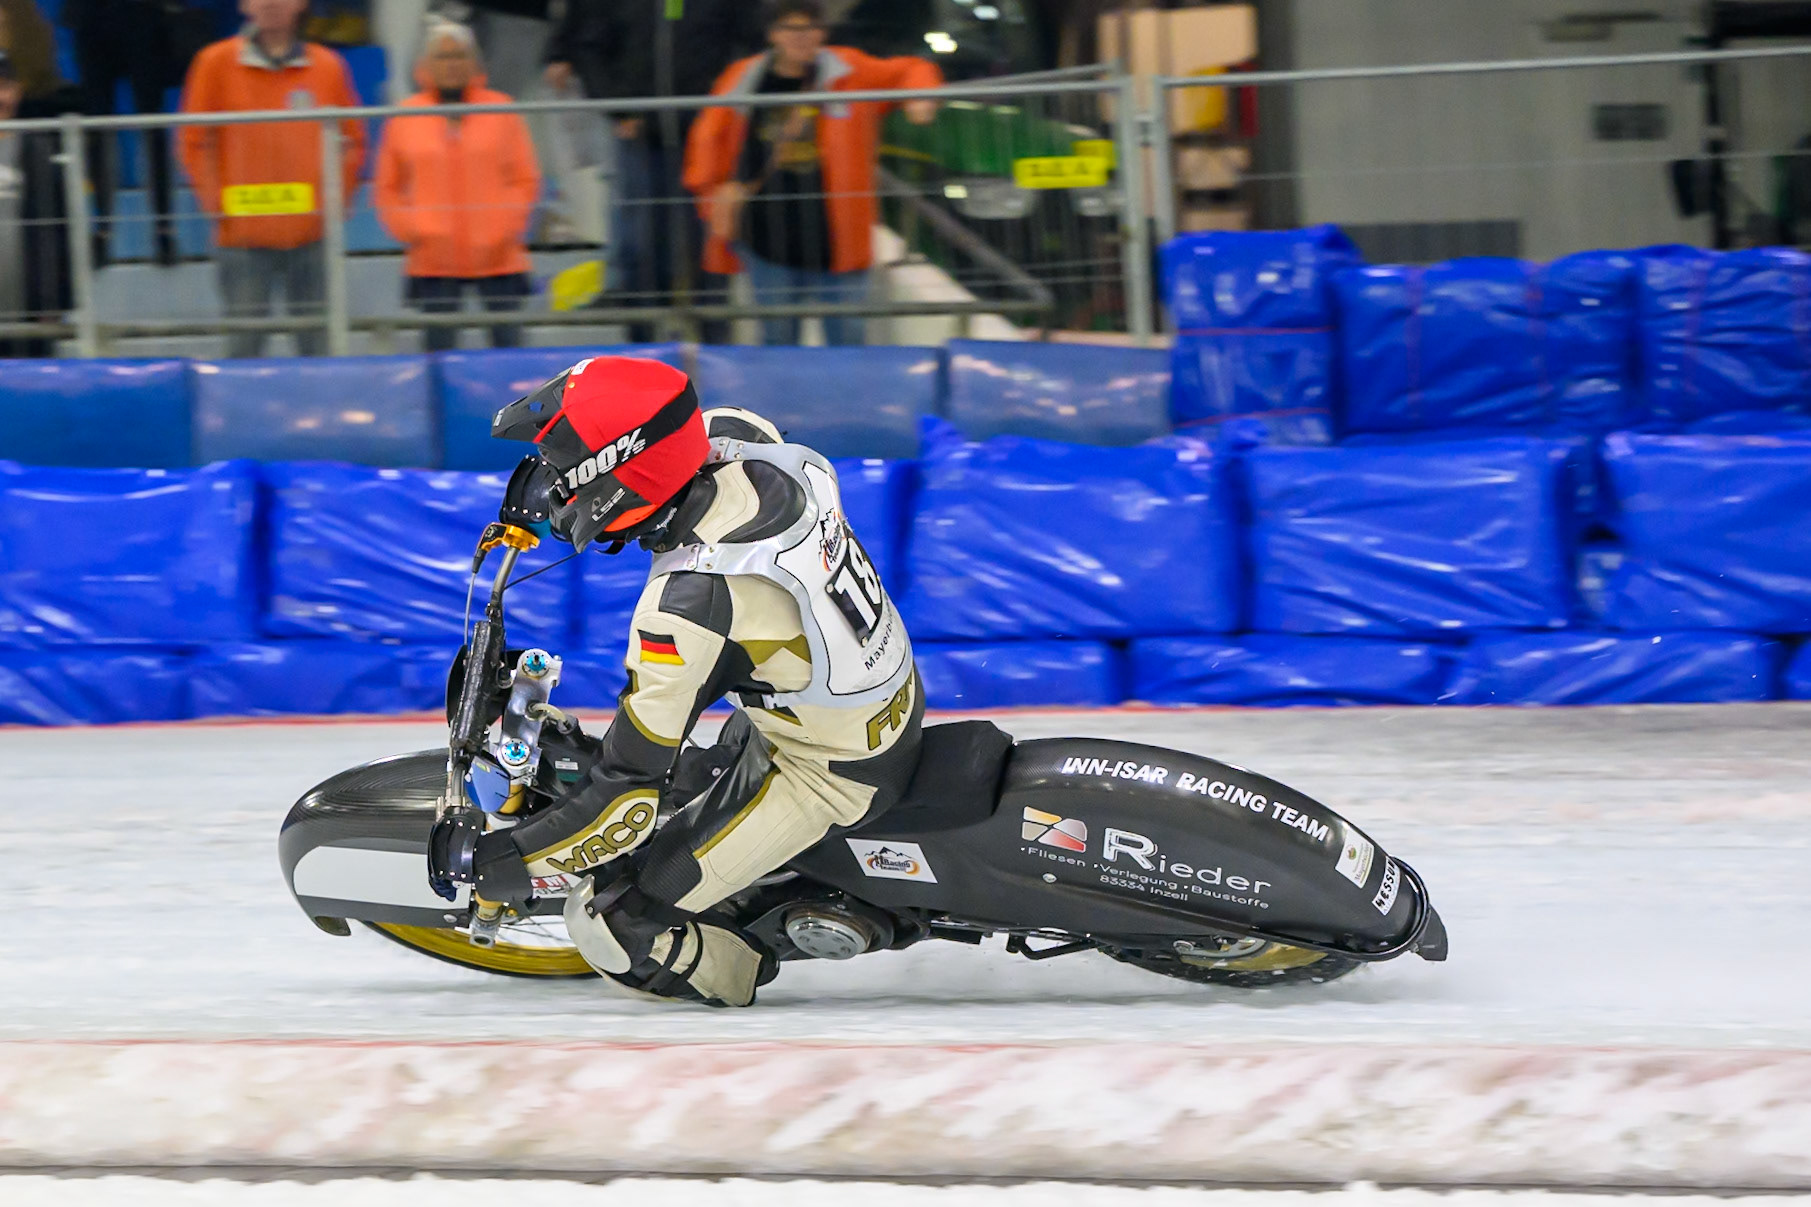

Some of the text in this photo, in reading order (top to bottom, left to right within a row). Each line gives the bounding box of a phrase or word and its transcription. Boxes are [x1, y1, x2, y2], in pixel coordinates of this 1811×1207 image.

[564, 427, 646, 490] 100%
[591, 487, 626, 522] LS2
[1061, 757, 1329, 842] INN-ISAR RACING TEAM
[545, 801, 655, 874] WACO
[1102, 827, 1272, 894] Rieder
[1099, 874, 1189, 901] 83334 Inzell
